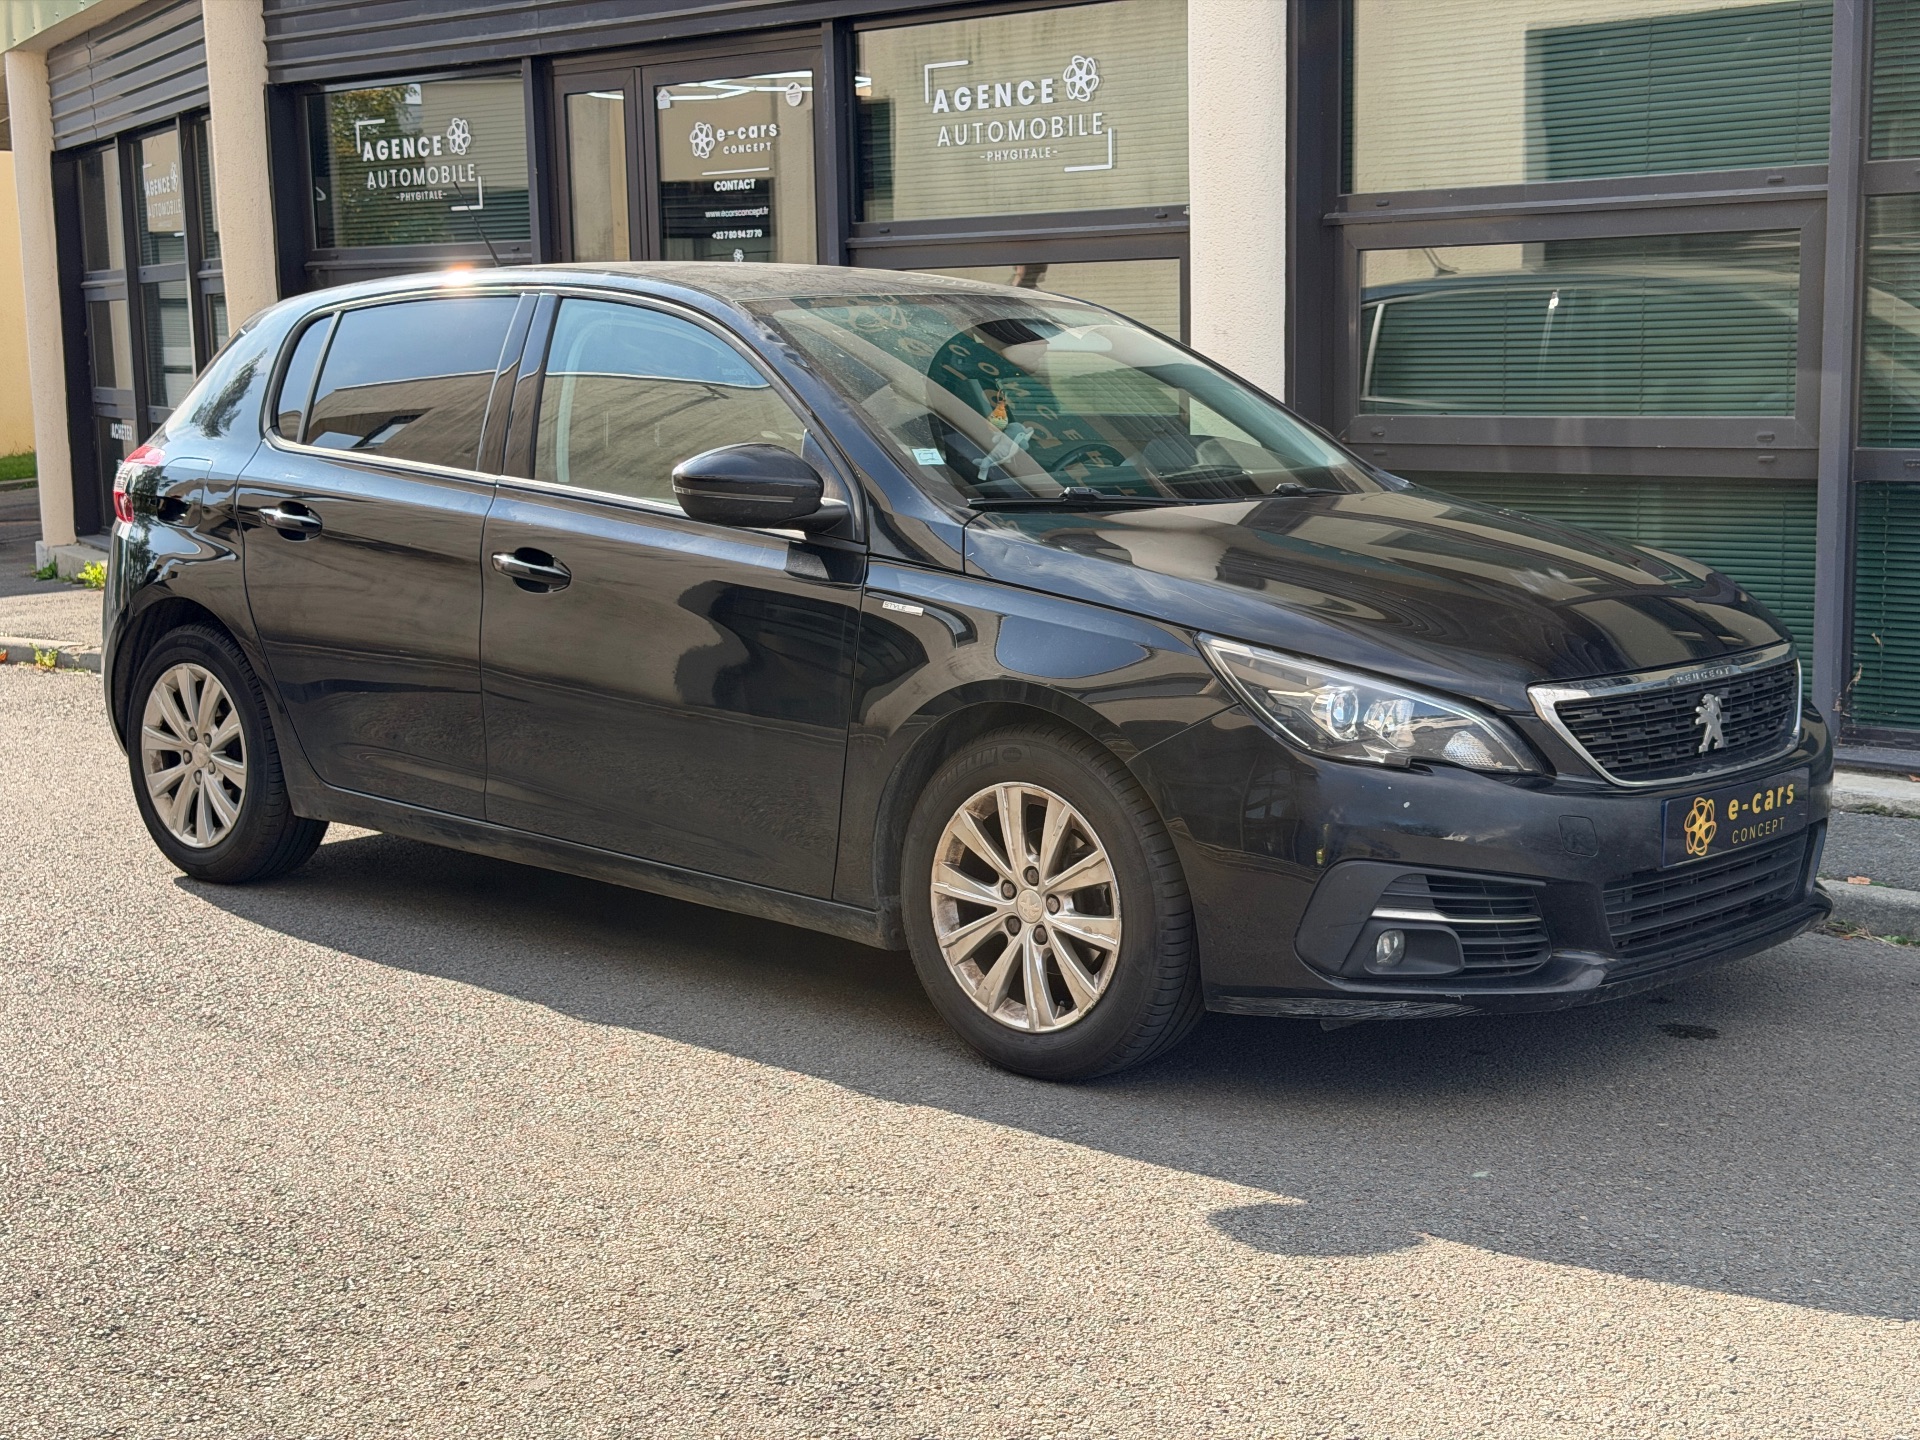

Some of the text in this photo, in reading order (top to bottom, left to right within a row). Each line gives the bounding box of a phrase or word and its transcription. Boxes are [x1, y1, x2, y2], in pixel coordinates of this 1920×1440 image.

[932, 78, 1054, 114] AGENCE
[716, 123, 778, 142] e-cars
[937, 112, 1103, 147] AUTOMOBILE
[362, 135, 443, 162] AGENCE
[722, 141, 772, 155] CONCEPT
[979, 147, 1058, 162] -PHYGITALE-
[145, 175, 171, 197] AGENCE
[366, 163, 476, 190] AUTOMOBILE
[713, 178, 756, 192] CONTACT
[884, 601, 906, 611] STYLE
[1676, 666, 1730, 684] PEUGEOT
[1727, 783, 1794, 821] e-cars
[1732, 816, 1785, 844] CONCEPT
